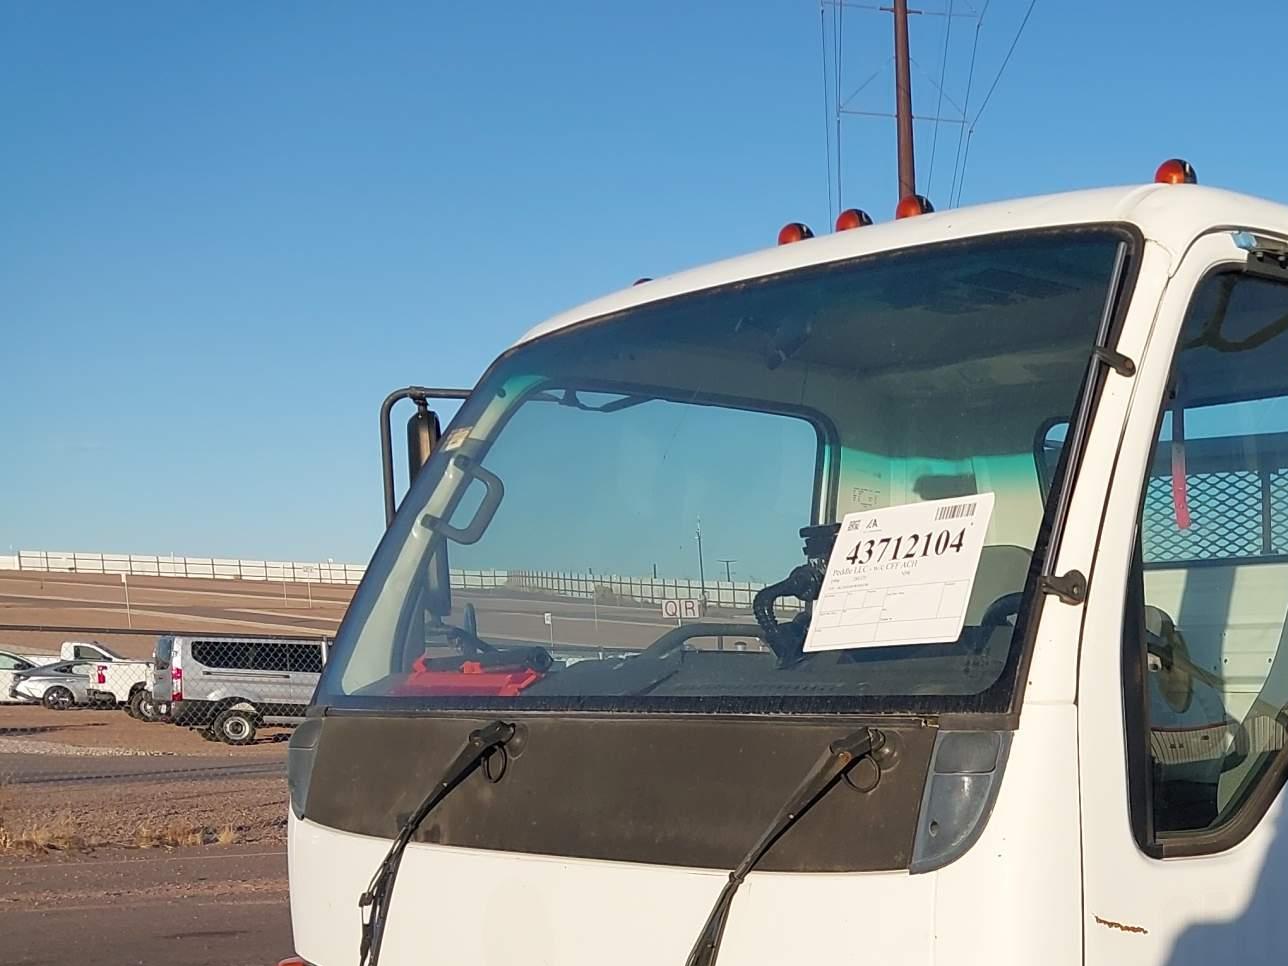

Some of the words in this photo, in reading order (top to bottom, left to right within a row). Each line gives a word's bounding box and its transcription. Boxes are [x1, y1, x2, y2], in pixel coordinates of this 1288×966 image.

[846, 527, 966, 565] 43712104
[665, 601, 678, 617] Q
[685, 601, 696, 616] R
